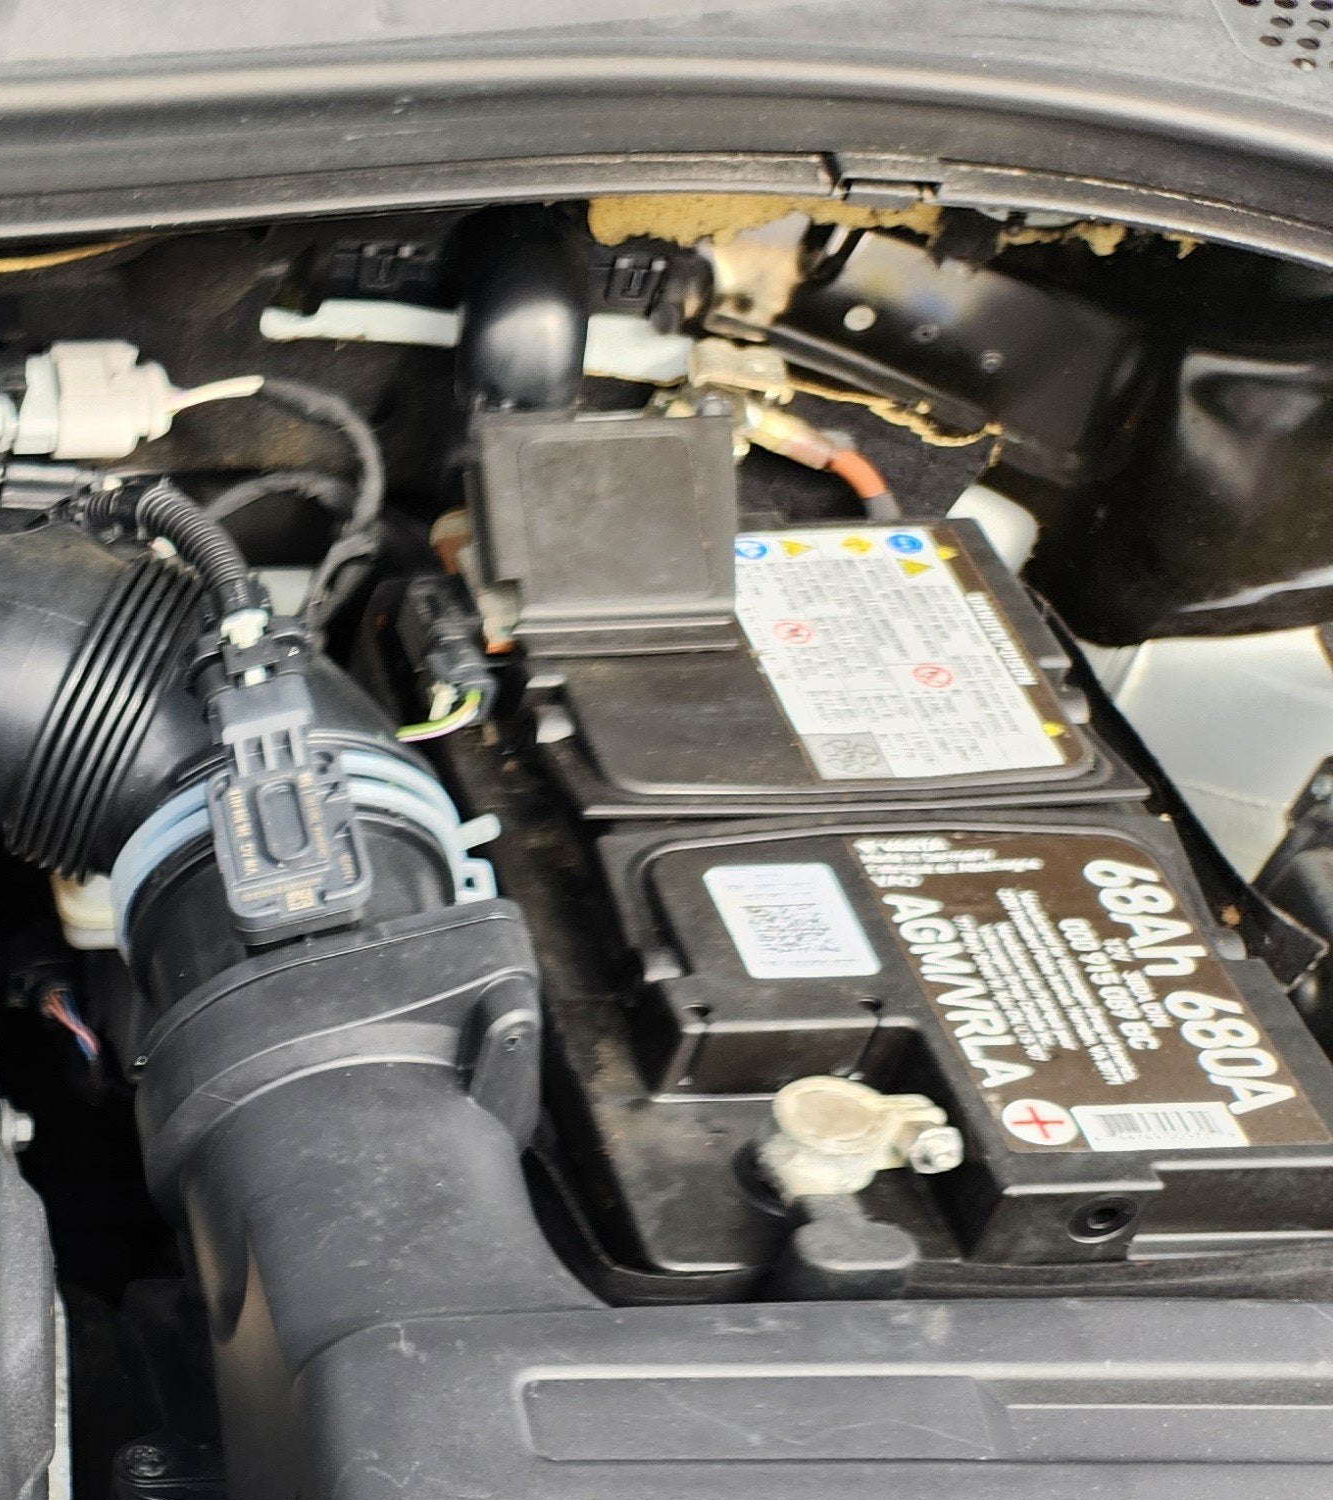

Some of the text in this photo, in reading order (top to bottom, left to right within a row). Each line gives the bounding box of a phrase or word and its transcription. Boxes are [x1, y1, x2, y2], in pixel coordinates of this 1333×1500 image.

[883, 893, 1035, 1087] AGM/VRLA
[1078, 951, 1122, 985] 915
[1083, 860, 1208, 976] 68Ah
[1164, 991, 1297, 1115] 680A
